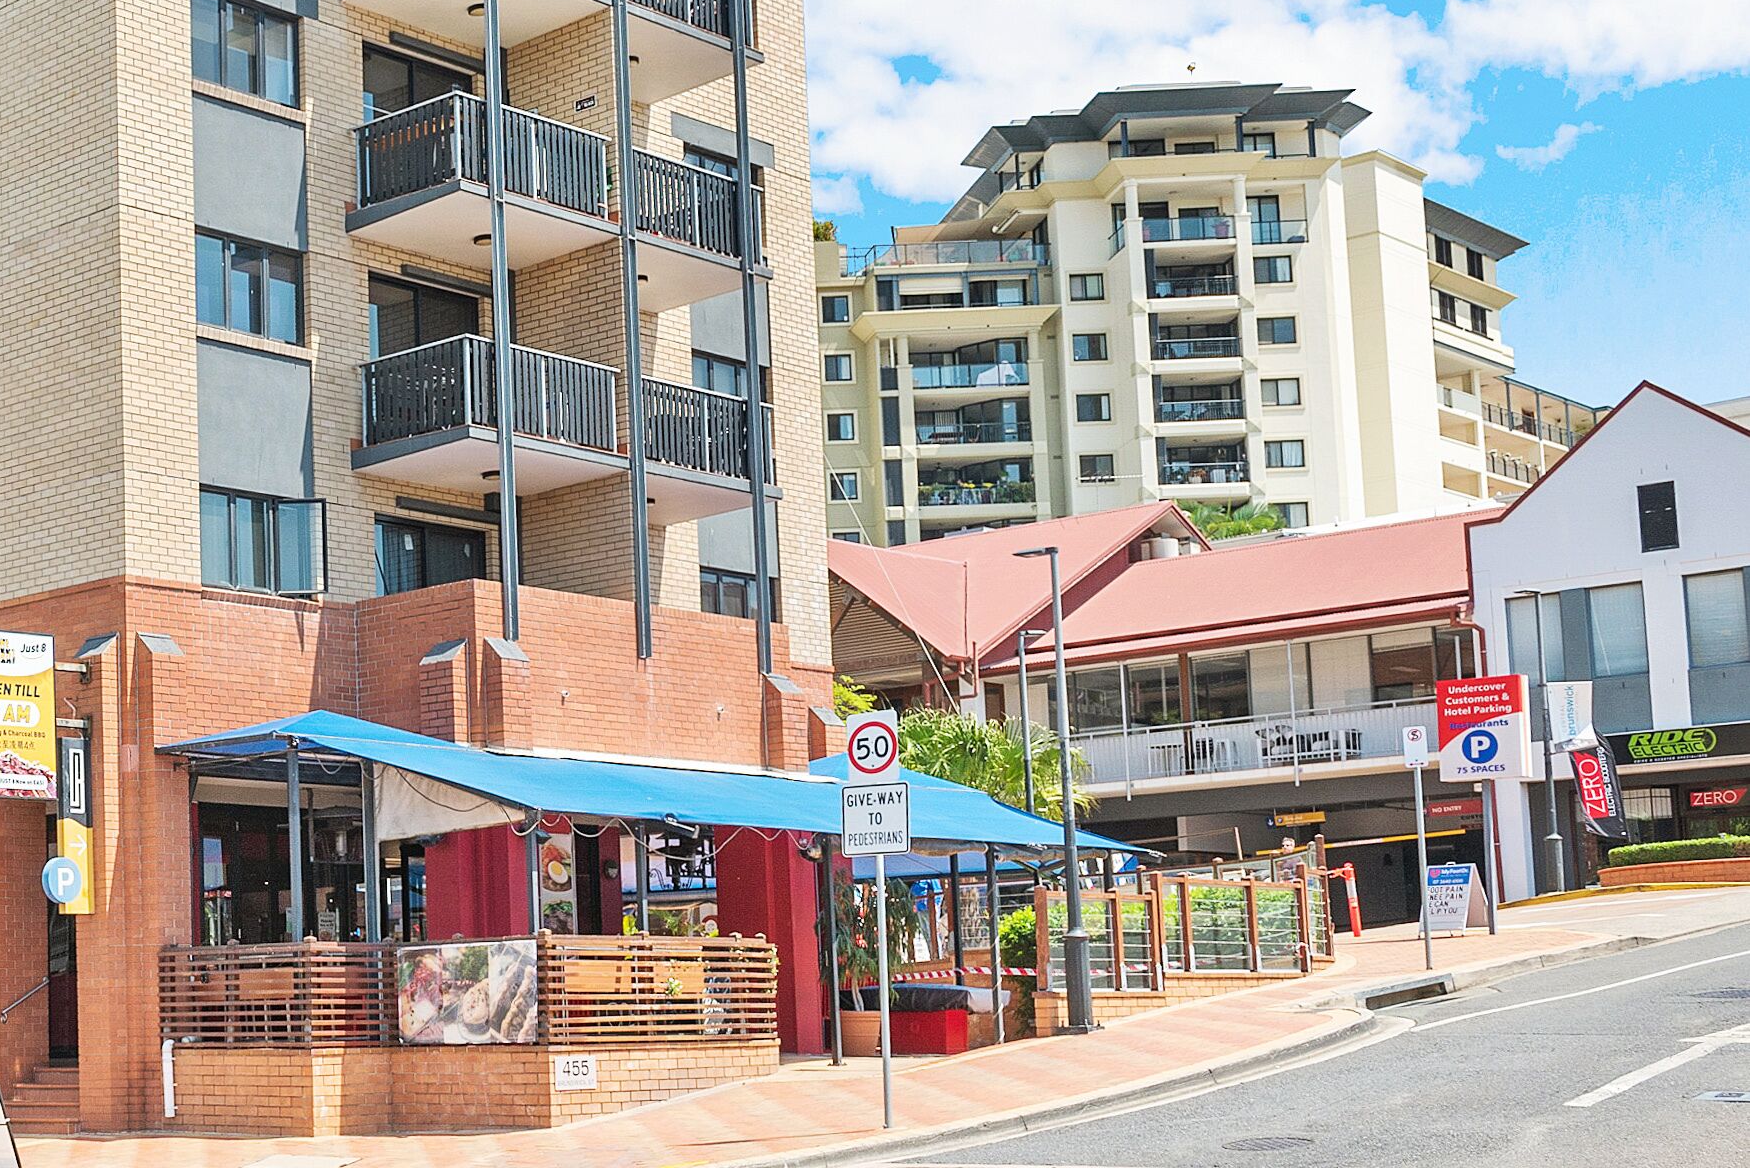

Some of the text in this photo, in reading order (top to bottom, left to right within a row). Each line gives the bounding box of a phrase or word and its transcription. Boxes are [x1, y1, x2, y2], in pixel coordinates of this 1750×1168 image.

[21, 643, 46, 652] Just 8
[15, 684, 40, 698] TILL
[1448, 683, 1506, 694] Undercover
[1446, 692, 1509, 705] Customers &
[3, 704, 30, 723] AM
[1444, 705, 1512, 716] Hotel Parking
[1565, 685, 1576, 736] brunswick
[1450, 719, 1508, 729] Restaurants
[1630, 728, 1707, 747] RIDE
[857, 736, 888, 760] 50
[1470, 736, 1490, 758] P
[1632, 742, 1704, 757] ELECTRIC
[1471, 764, 1505, 772] SPACES
[1579, 758, 1606, 813] ZERO
[1693, 790, 1737, 805] ZERO
[868, 812, 882, 825] TO
[848, 830, 903, 846] PEDESTRIANS
[57, 867, 75, 896] P
[563, 1060, 589, 1076] 455
